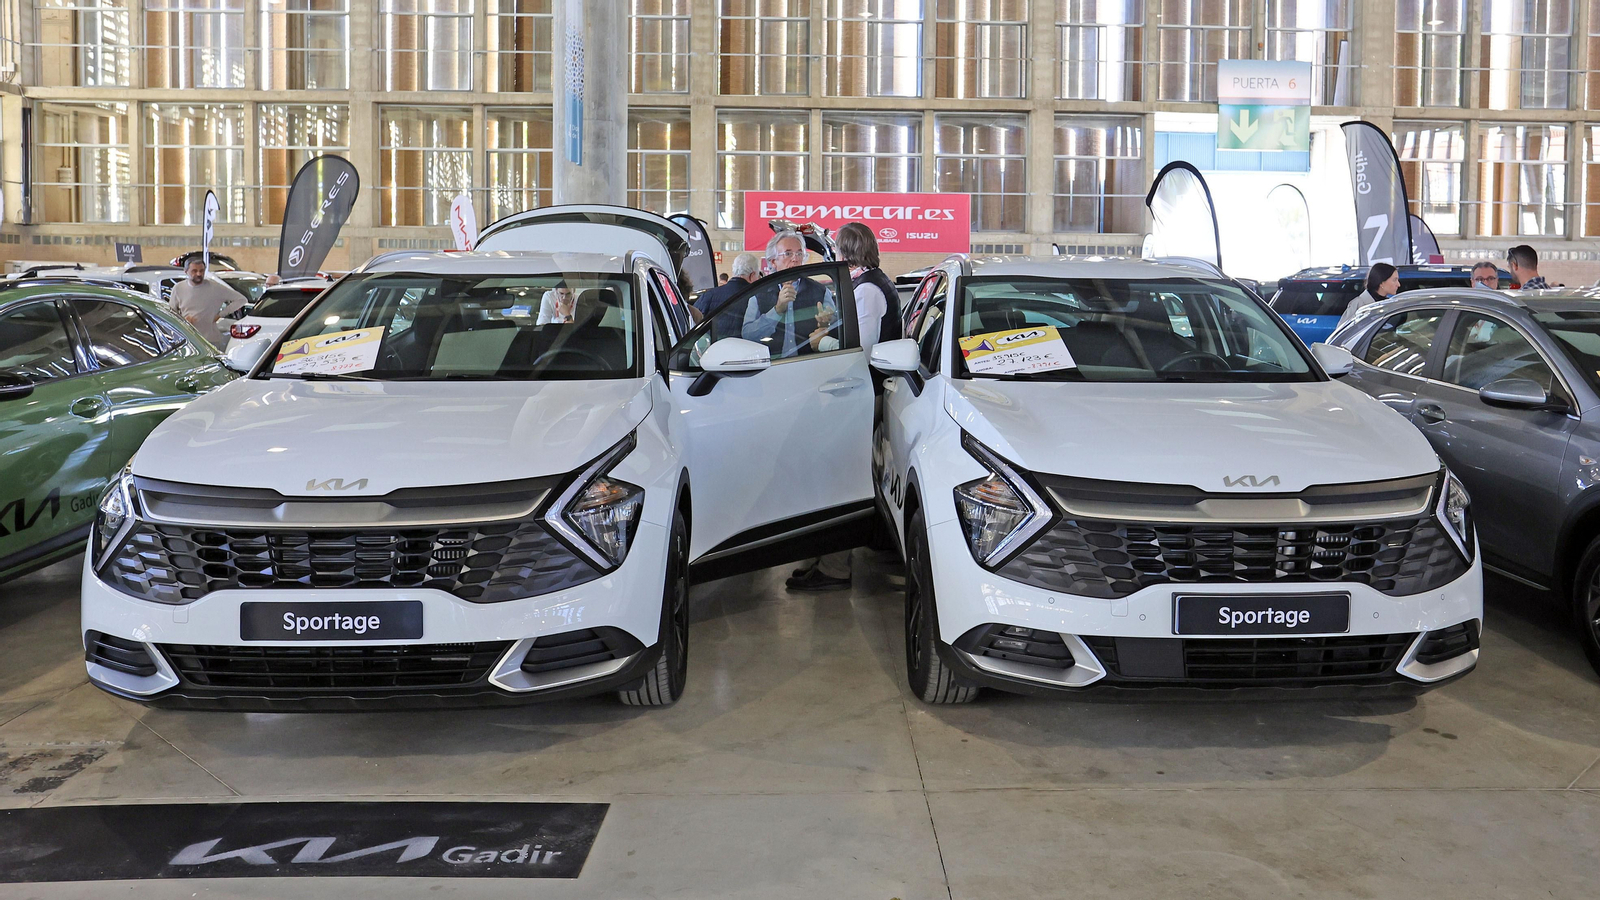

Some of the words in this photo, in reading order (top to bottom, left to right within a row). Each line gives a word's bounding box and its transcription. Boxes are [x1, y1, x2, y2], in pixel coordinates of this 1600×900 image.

[1232, 77, 1280, 90] PUERTA
[1288, 78, 1297, 90] 6
[300, 170, 350, 246] SERES
[759, 200, 956, 221] Bemecar.es
[906, 231, 939, 240] ISUZU
[1296, 317, 1318, 325] KIA
[1006, 331, 1038, 342] KIA
[305, 478, 369, 491] KIA
[1222, 475, 1281, 487] KIA
[282, 611, 381, 635] Sportage
[1218, 606, 1311, 629] Sportage
[168, 836, 440, 865] KIA
[441, 844, 562, 865] Gadir
